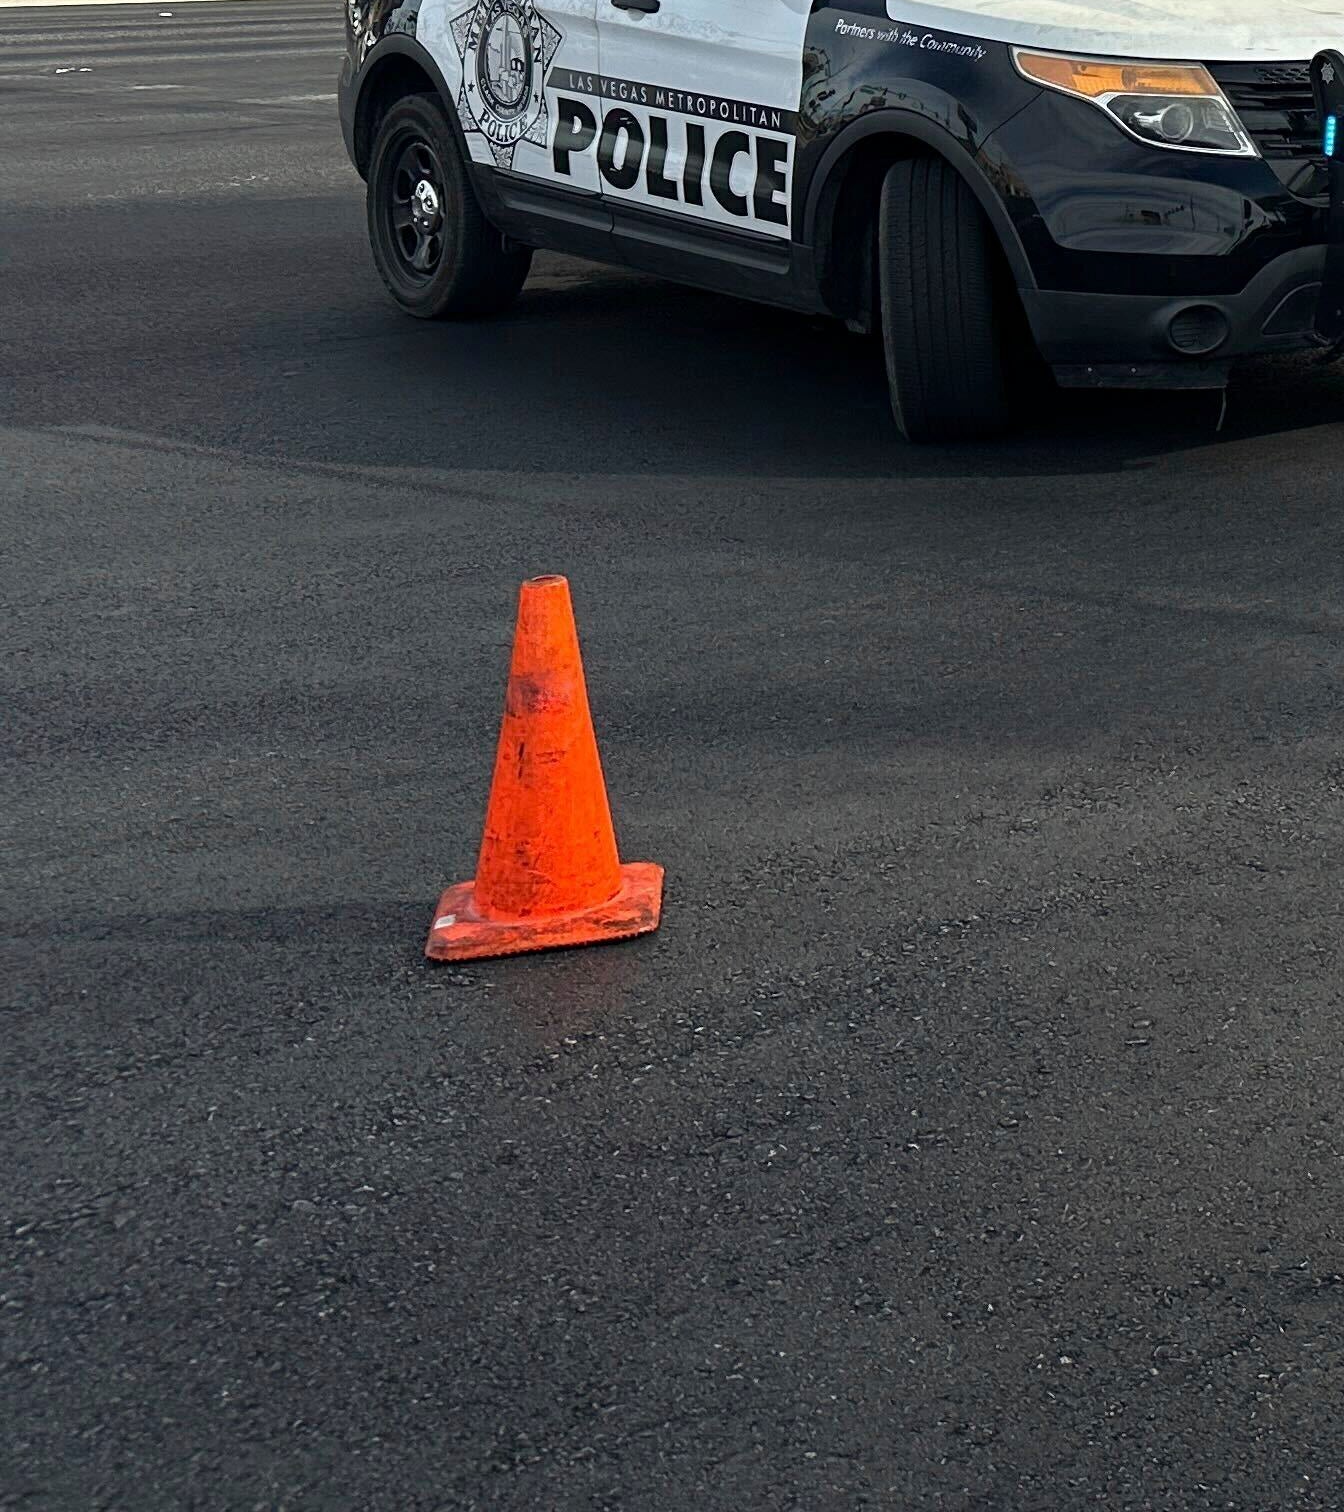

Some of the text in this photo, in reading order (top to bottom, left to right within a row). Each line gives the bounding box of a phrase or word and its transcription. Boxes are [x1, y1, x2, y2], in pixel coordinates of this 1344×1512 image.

[834, 18, 988, 63] Partners with the Community
[478, 108, 528, 143] POLICE
[569, 74, 781, 128] LAS VEGAS METROPOLITAN
[553, 97, 788, 226] POLICE
